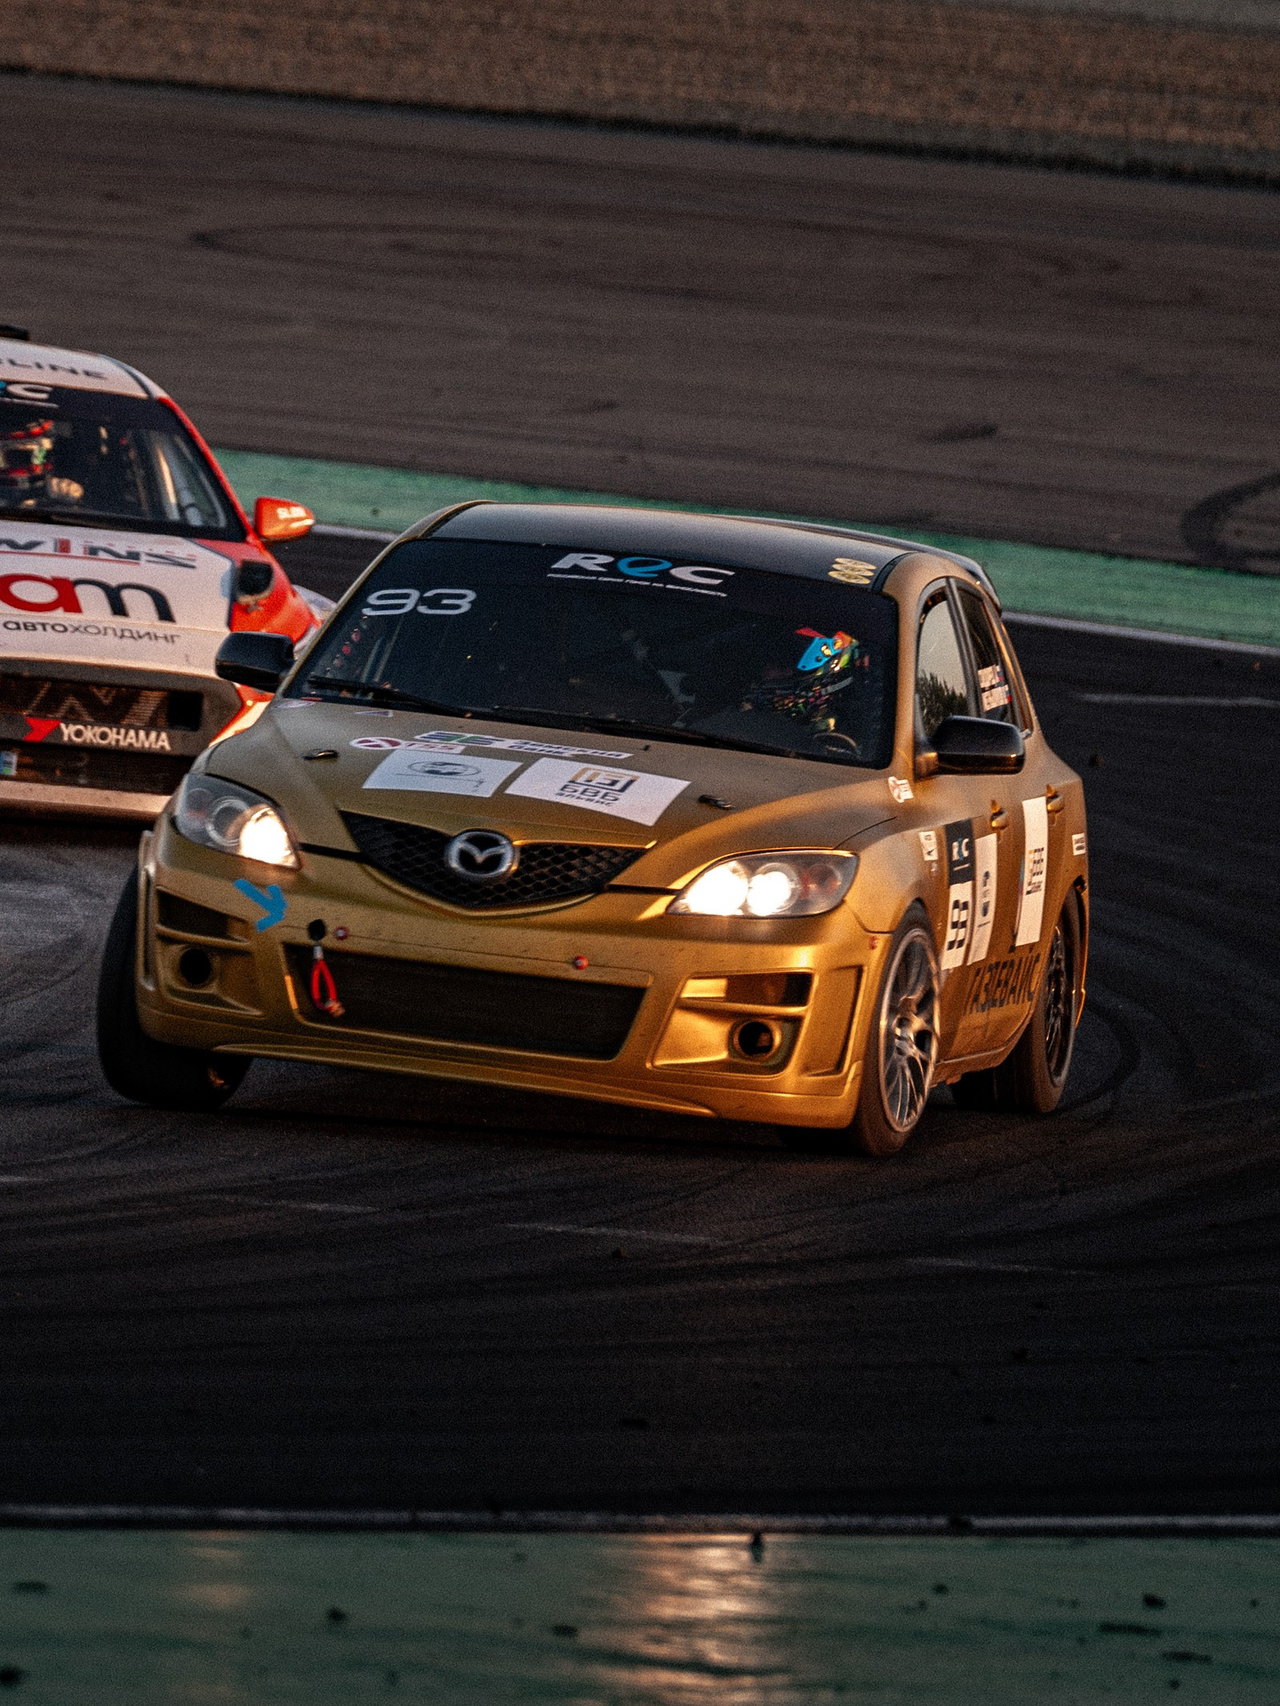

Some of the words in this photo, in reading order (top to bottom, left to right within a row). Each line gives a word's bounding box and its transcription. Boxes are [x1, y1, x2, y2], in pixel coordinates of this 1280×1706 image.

[362, 588, 478, 616] 93
[3, 619, 182, 645] автохолдинг
[60, 722, 171, 751] YOKOHAMA
